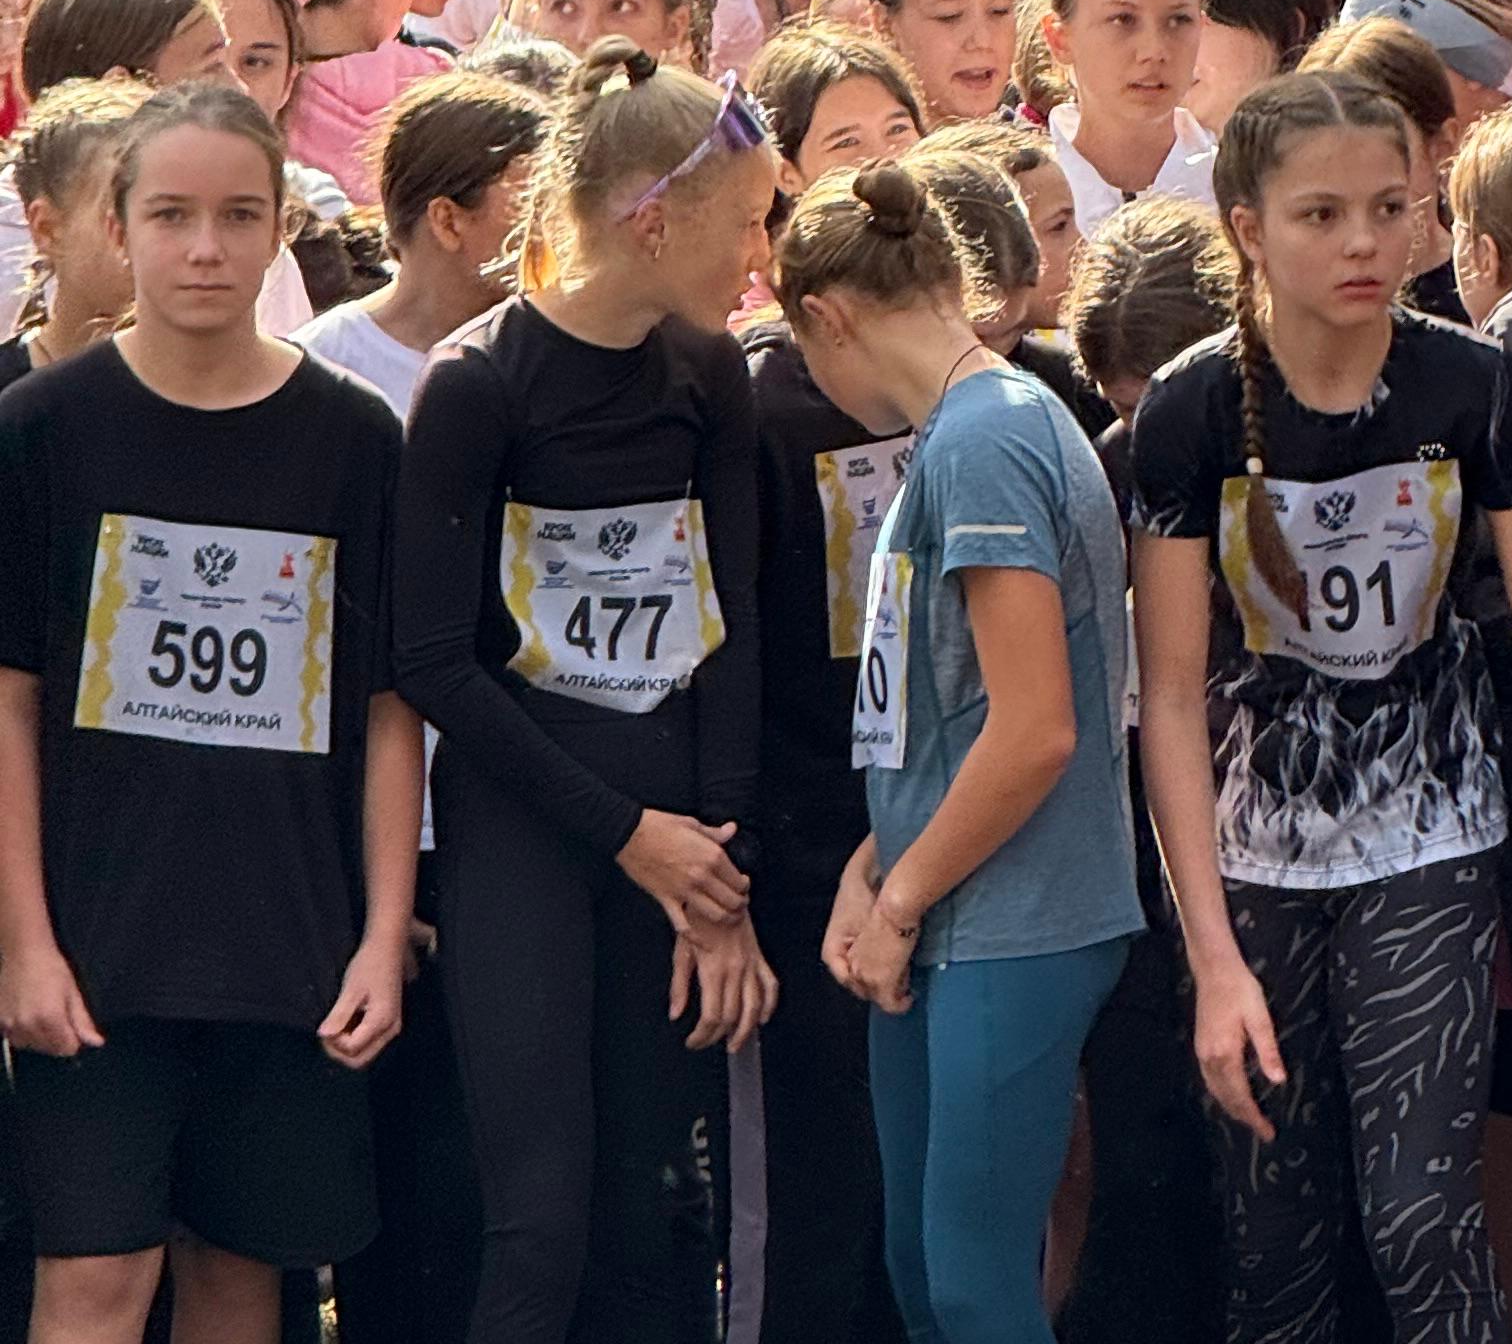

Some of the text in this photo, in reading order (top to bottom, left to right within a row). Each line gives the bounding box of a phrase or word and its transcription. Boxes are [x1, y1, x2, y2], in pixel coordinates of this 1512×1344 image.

[564, 594, 673, 662] 477
[147, 620, 268, 697] 599
[555, 673, 681, 692] АЛТАЙСКИЙ КРА
[122, 701, 282, 731] АЛТАЙСКИЙ КРАЙ
